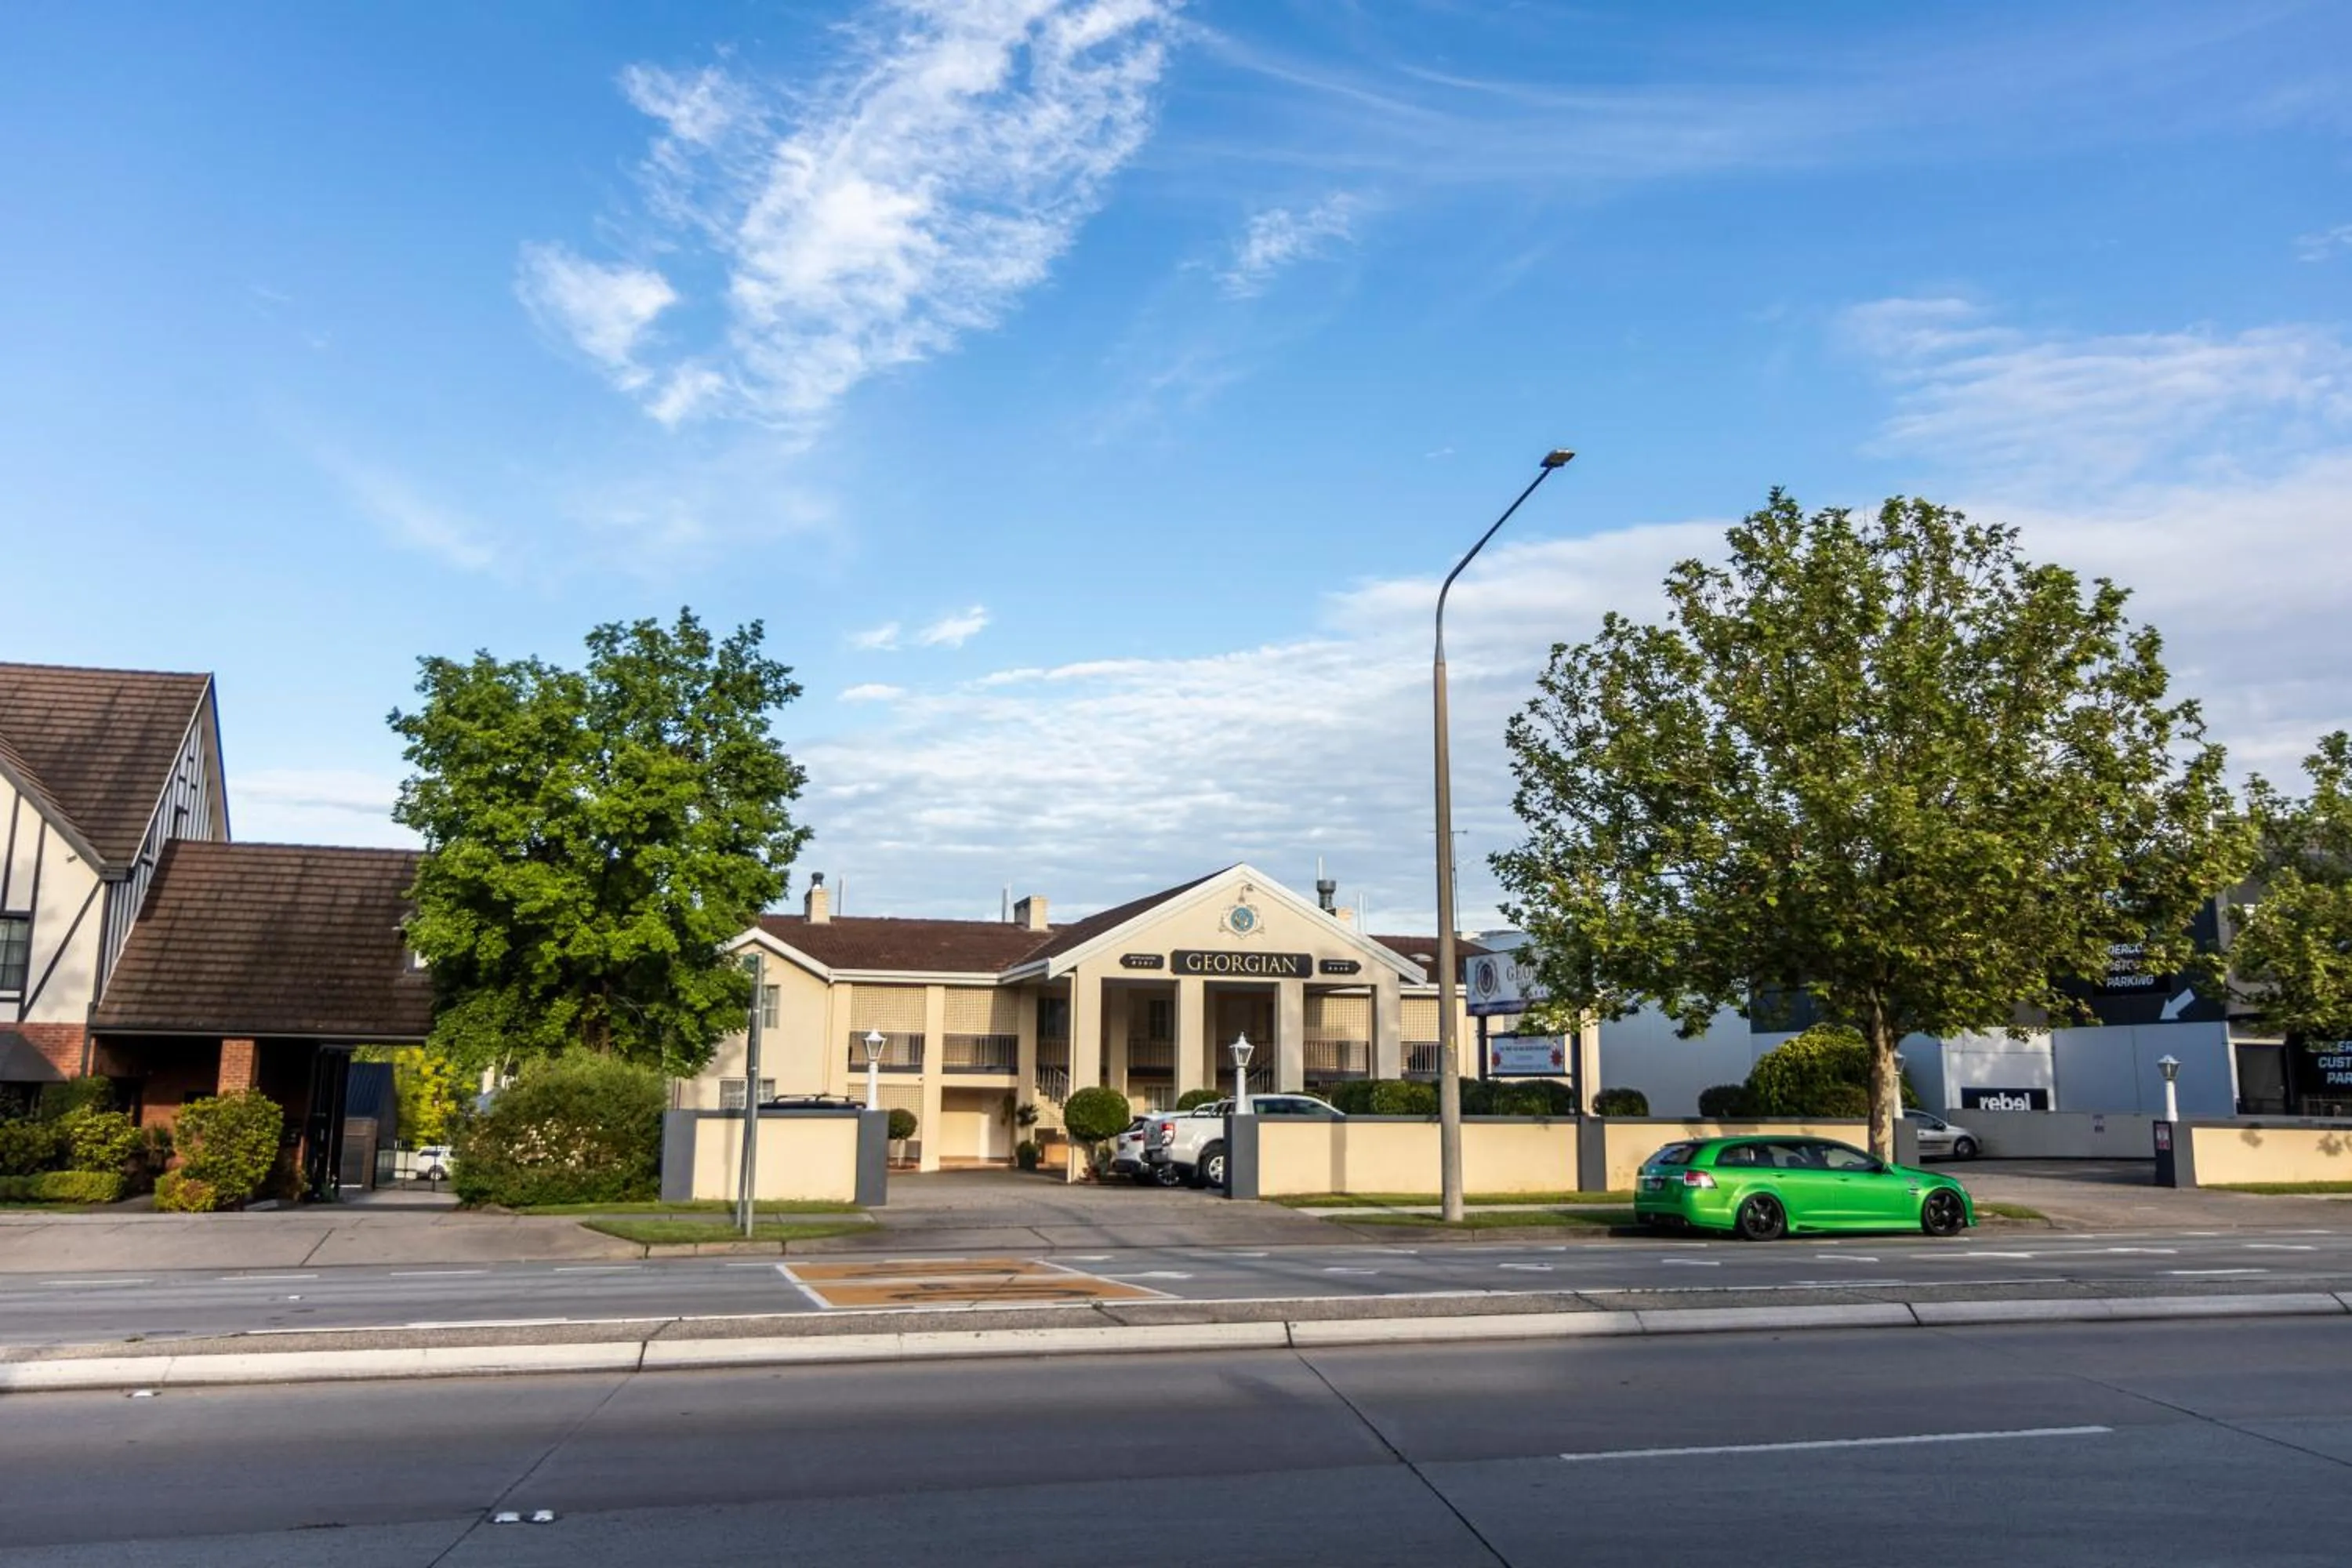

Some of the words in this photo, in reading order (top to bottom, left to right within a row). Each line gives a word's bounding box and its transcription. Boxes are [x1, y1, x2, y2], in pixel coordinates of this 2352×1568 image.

[1186, 953, 1298, 973] GEORGIAN
[2107, 975, 2154, 987] PARKING
[1979, 1092, 2031, 1111] rebel
